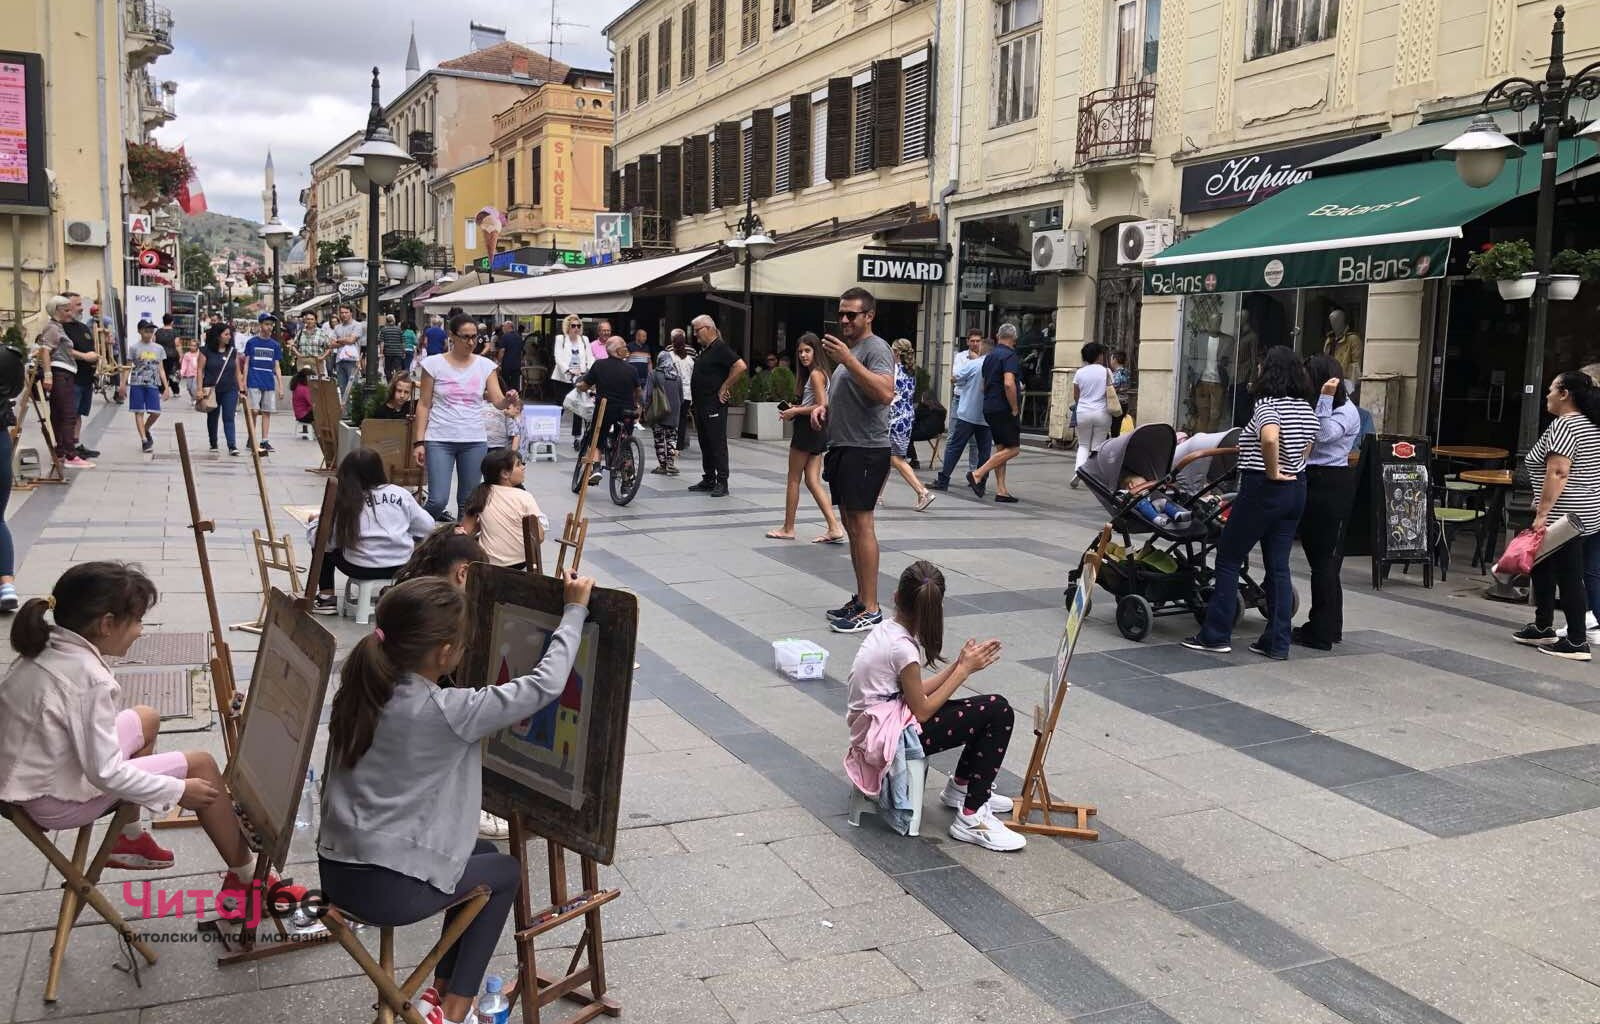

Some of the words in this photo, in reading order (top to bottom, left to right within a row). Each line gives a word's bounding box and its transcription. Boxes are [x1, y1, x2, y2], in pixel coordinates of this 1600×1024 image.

[554, 141, 565, 220] SINGER
[131, 217, 149, 233] A1
[862, 259, 943, 281] EDWARD
[1339, 254, 1411, 283] Balans
[1151, 271, 1202, 294] Balans
[135, 294, 157, 303] ROSA
